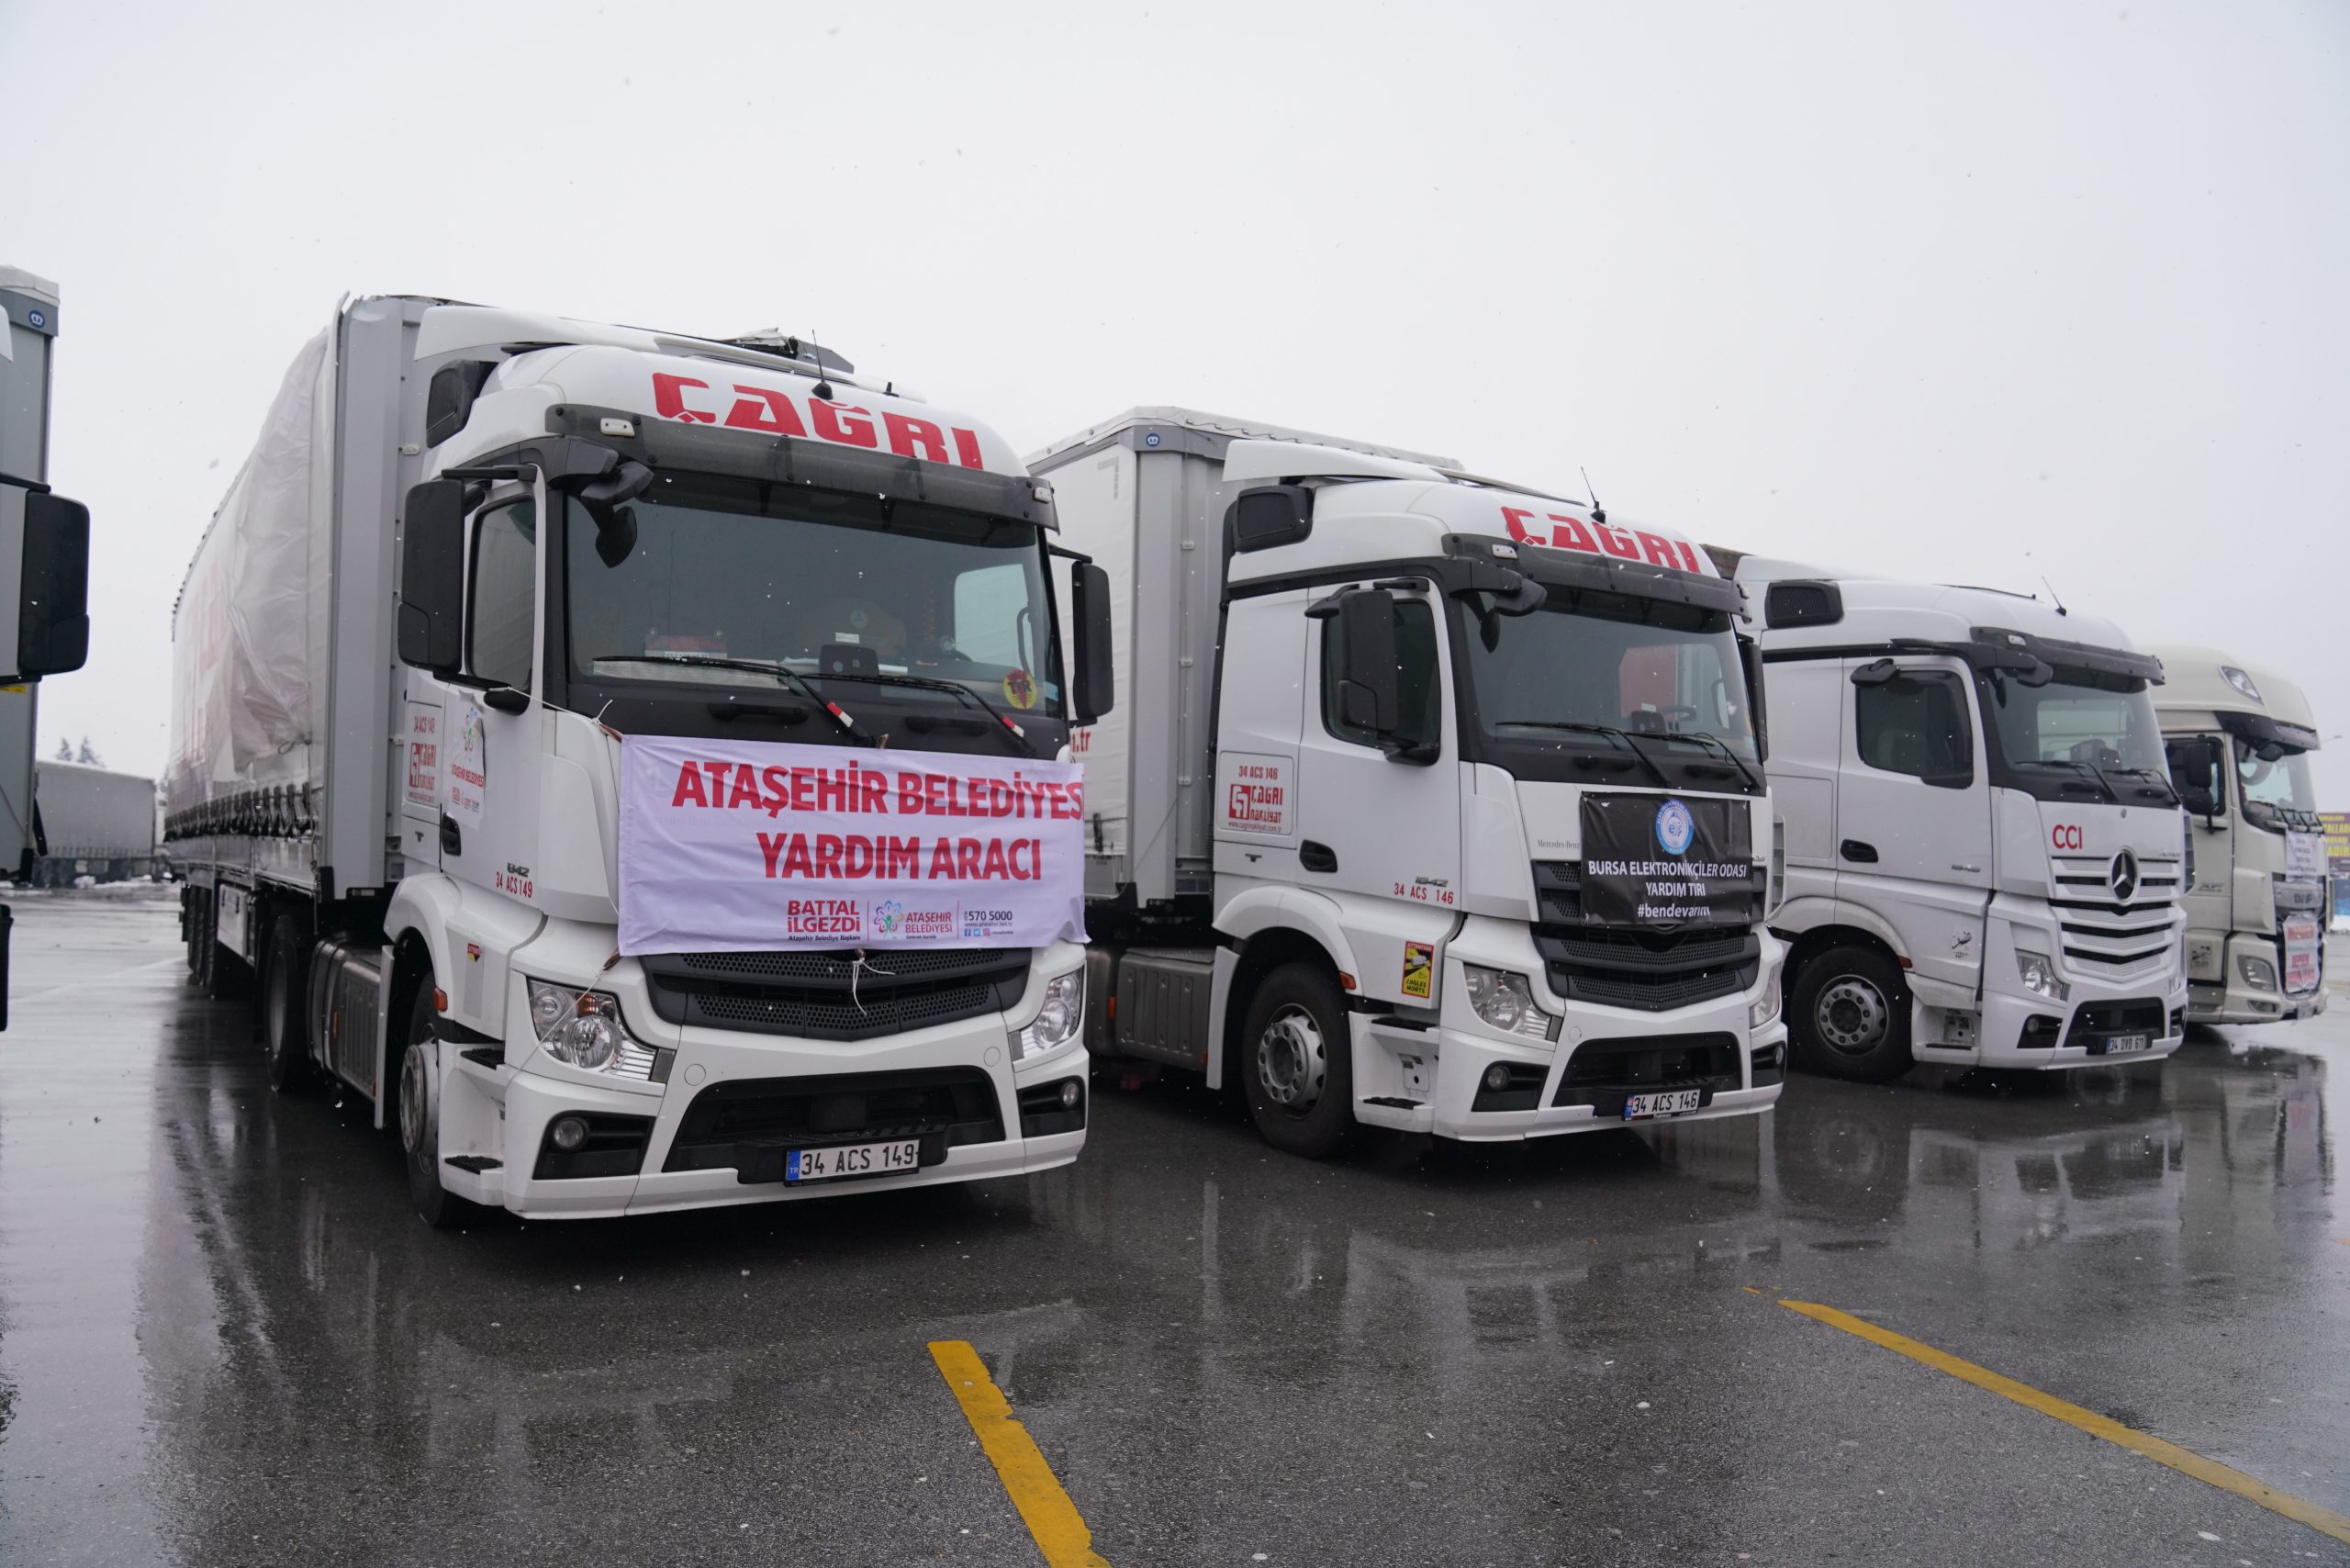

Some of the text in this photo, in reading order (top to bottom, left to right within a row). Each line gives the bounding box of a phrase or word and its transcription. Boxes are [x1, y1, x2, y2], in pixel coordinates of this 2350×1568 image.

[653, 372, 983, 470] ÇAĞRI
[1501, 506, 1700, 574] ÇAĞRI
[672, 760, 1085, 822] ATAŞEHİR BELEDİYES
[2052, 824, 2082, 849] CCI
[756, 832, 1041, 880] YARDIM ARACI
[1588, 859, 1747, 880] BURSA ELEKTRONİKÇİLER ODASI
[496, 872, 533, 899] 34 ACS 149
[1393, 883, 1454, 904] 34 ACS 146
[1646, 882, 1707, 897] YARDIM TIRI
[788, 900, 859, 915] BATTAL
[968, 911, 987, 921] 570
[989, 911, 1013, 921] 5000
[788, 916, 860, 933] İLGEZDİ
[1632, 1092, 1697, 1114] 34 ACS 146
[801, 1153, 824, 1175] 34
[835, 1148, 870, 1172] ACS
[883, 1144, 914, 1167] 149
